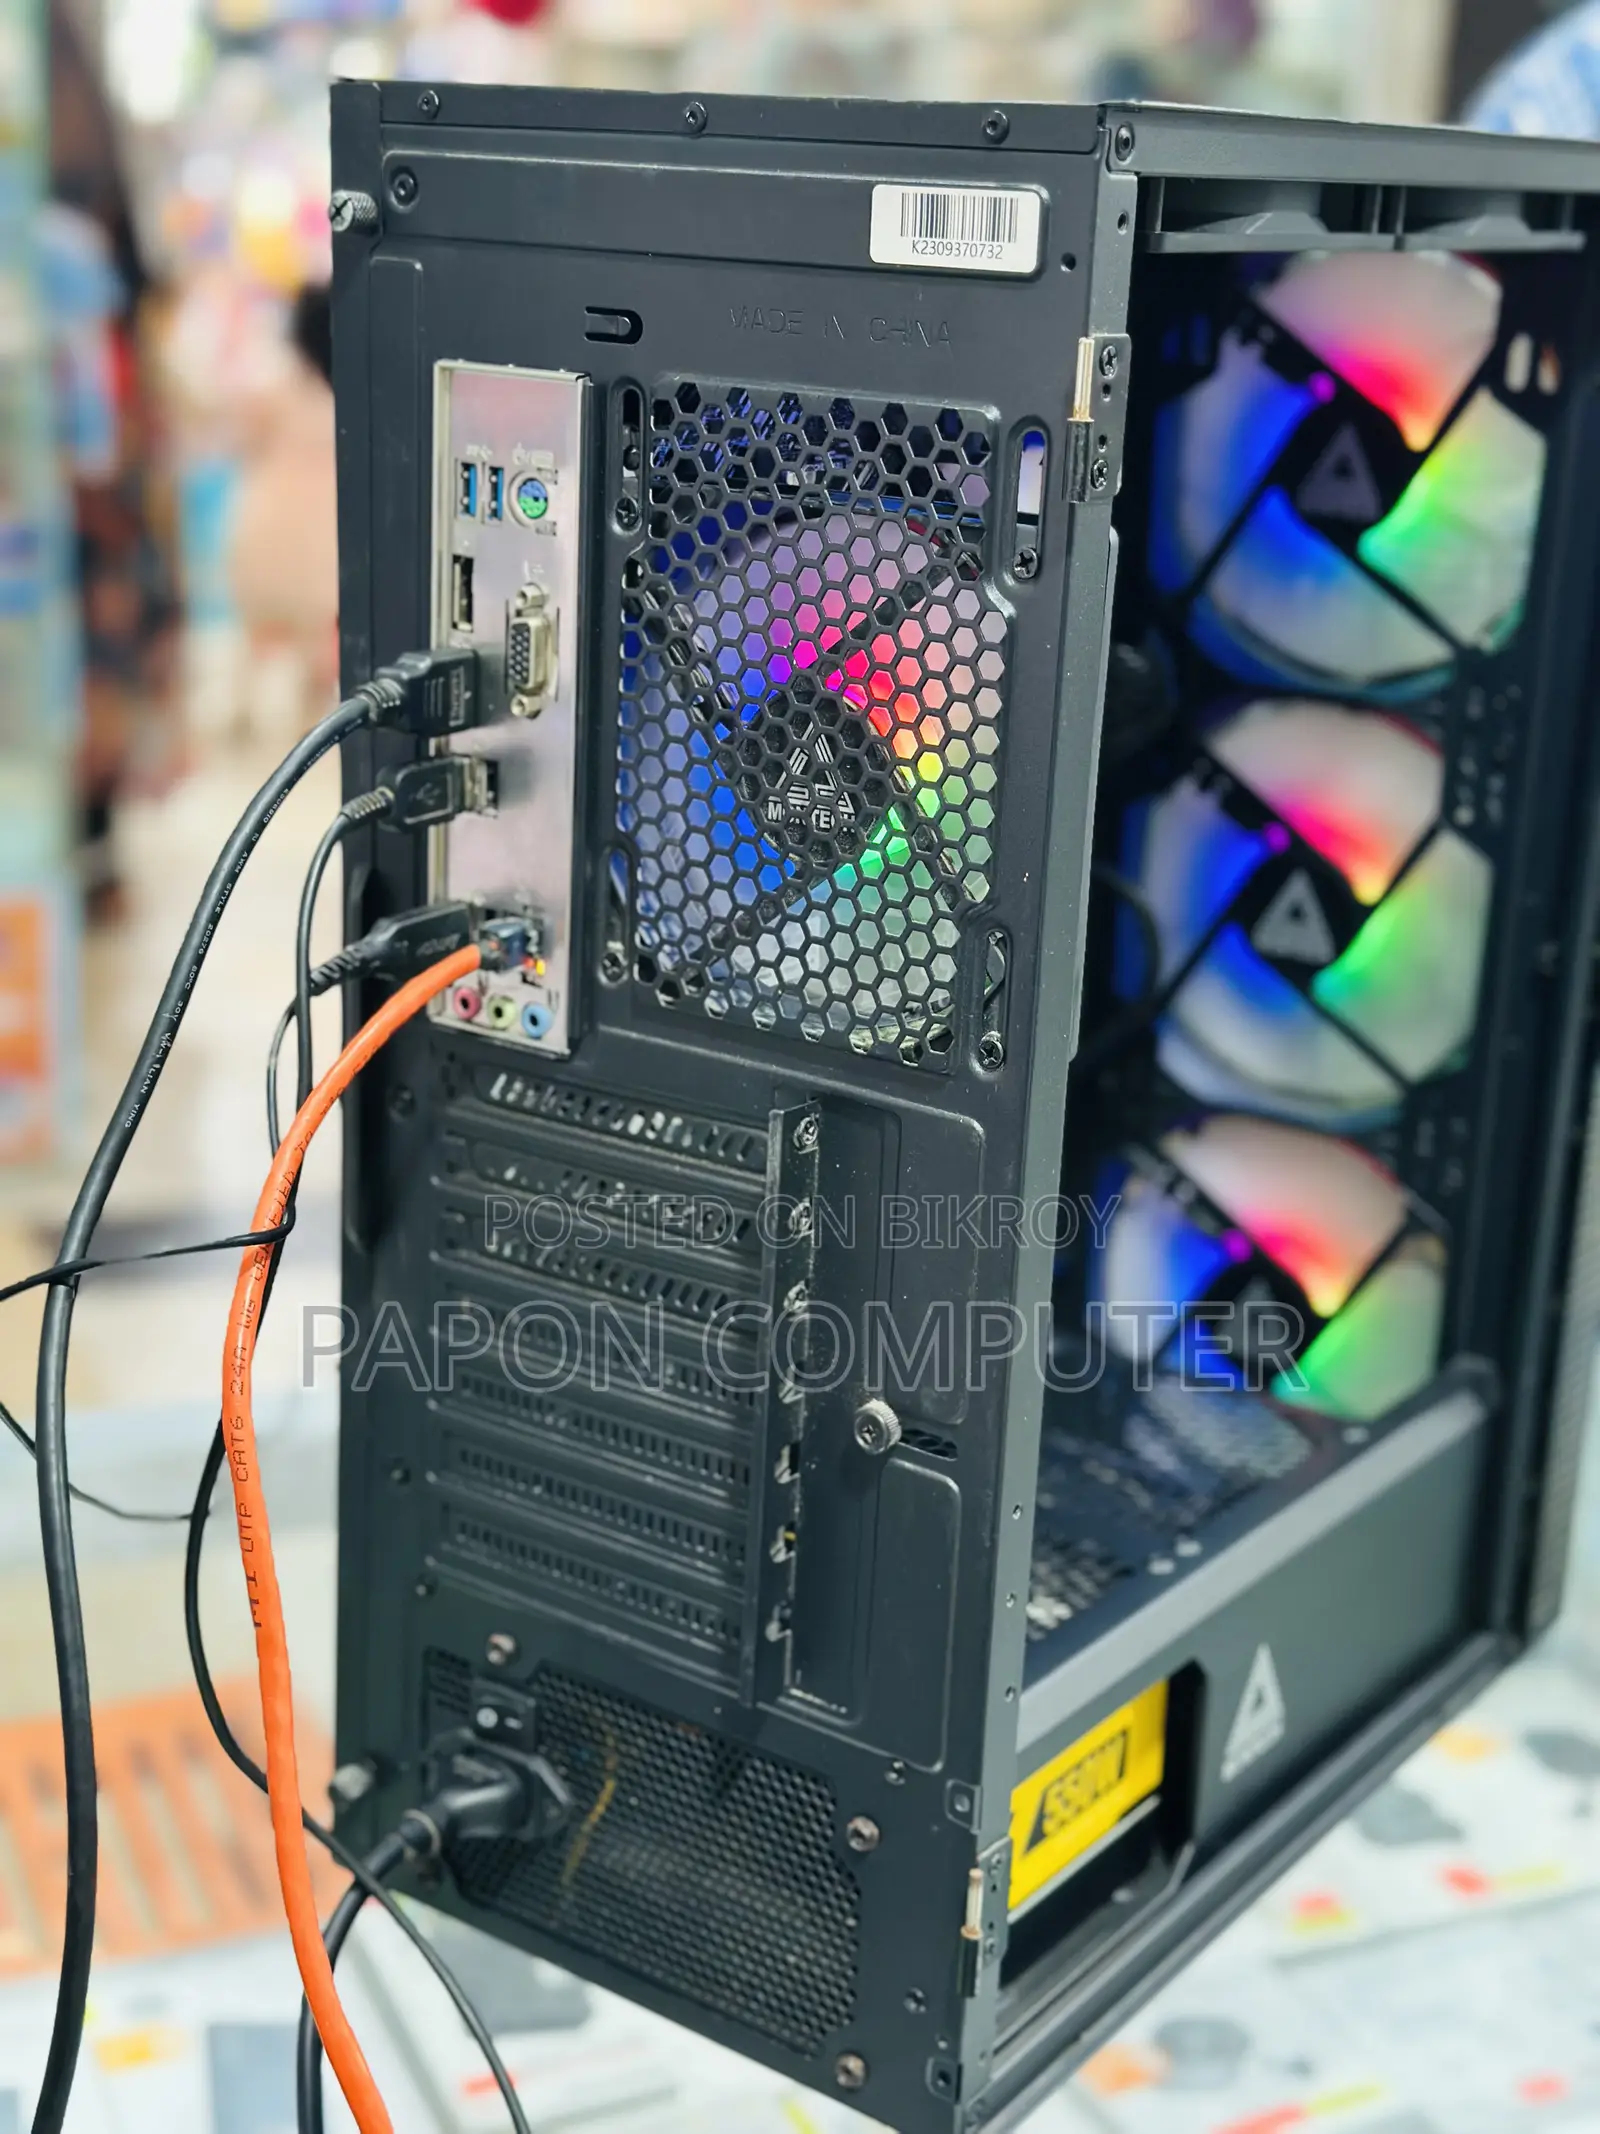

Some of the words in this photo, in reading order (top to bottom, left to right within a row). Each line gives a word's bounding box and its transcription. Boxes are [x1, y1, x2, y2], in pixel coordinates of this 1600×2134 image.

[911, 239, 1004, 260] K2309370732
[730, 305, 804, 335] MADE
[823, 313, 846, 340] IN
[868, 316, 952, 349] CHINA
[234, 851, 248, 873] AWM
[214, 882, 232, 914] STYLE
[124, 1102, 141, 1129] YING
[232, 1414, 249, 1484] CAT6
[237, 1501, 254, 1554] UTP
